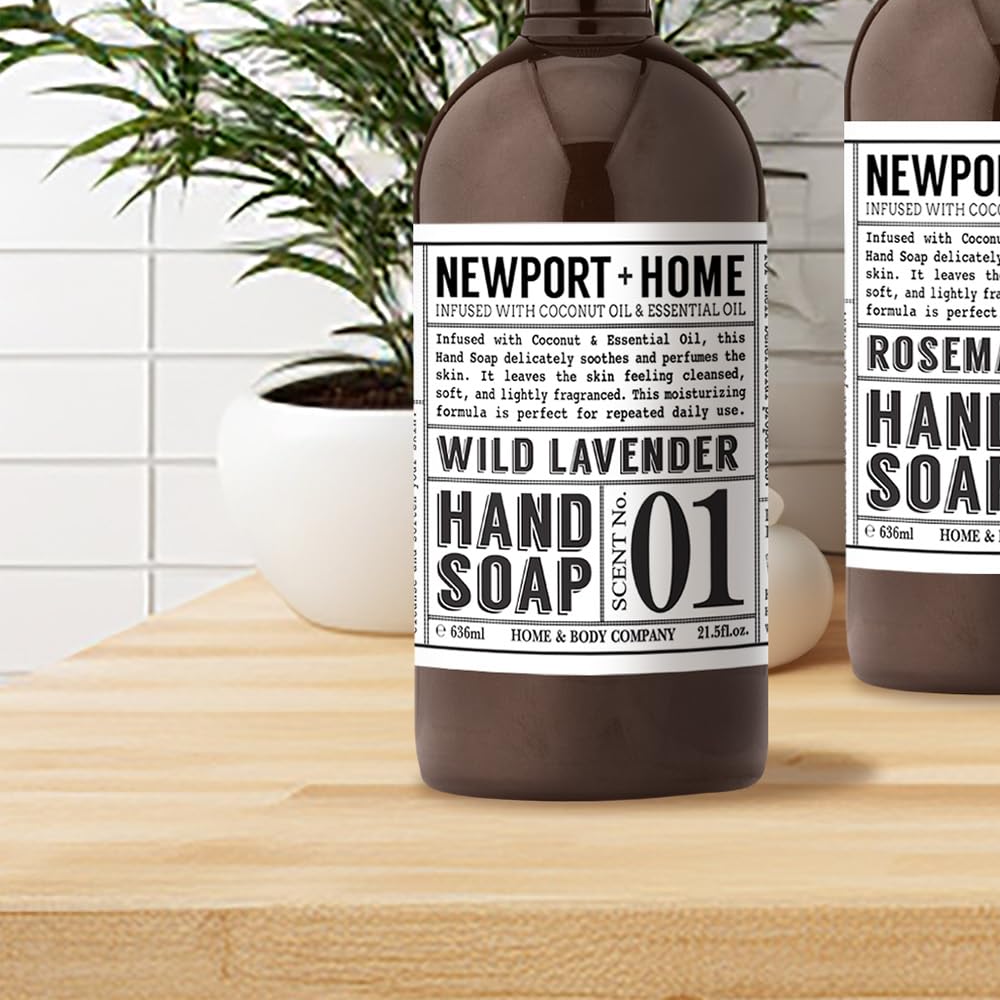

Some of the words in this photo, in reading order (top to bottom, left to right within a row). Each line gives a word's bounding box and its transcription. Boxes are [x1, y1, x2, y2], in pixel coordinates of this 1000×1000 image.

[866, 201, 922, 216] INFUSED
[925, 202, 965, 217] WITH
[866, 230, 915, 244] Infused
[923, 231, 952, 245] with
[865, 249, 894, 262] Hand
[899, 250, 928, 266] Soap
[436, 255, 612, 299] NEWPORT
[617, 266, 633, 286] +
[640, 254, 746, 299] HOME
[865, 267, 899, 280] skin.
[910, 269, 925, 281] It
[934, 268, 976, 281] leaves
[865, 285, 898, 300] soft,
[904, 286, 925, 299] and
[930, 286, 978, 303] lightly
[435, 303, 492, 318] INFUSED
[495, 304, 536, 318] WITH
[538, 303, 606, 319] COCONUT
[608, 303, 633, 318] OIL
[635, 303, 644, 318] &
[647, 302, 721, 318] ESSENTIAL
[722, 301, 747, 317] OIL
[866, 303, 917, 317] formula
[925, 304, 939, 318] is
[946, 305, 998, 321] perfect
[436, 332, 485, 345] Infused
[493, 332, 522, 346] with
[531, 334, 581, 346] Coconut
[590, 335, 598, 346] &
[607, 332, 670, 346] Essential
[678, 331, 707, 347] Oil,
[716, 330, 746, 345] this
[435, 350, 464, 363] Hand
[469, 351, 498, 367] Soap
[503, 351, 575, 368] delicately
[580, 351, 630, 365] soothes
[635, 350, 657, 364] and
[661, 350, 719, 368] perfumes
[724, 348, 746, 362] the
[436, 368, 469, 381] skin.
[481, 370, 495, 382] It
[504, 369, 546, 382] leaves
[555, 369, 577, 383] the
[586, 369, 615, 383] skin
[624, 368, 674, 385] feeling
[682, 366, 745, 382] cleansed,
[435, 386, 468, 401] soft,
[474, 387, 496, 400] and
[500, 387, 548, 404] lightly
[553, 387, 626, 405] fragranced.
[631, 387, 660, 401] This
[663, 385, 747, 401] moisturizing
[436, 404, 487, 418] formula
[495, 405, 509, 419] is
[516, 406, 568, 422] perfect
[577, 406, 598, 420] for
[606, 405, 665, 423] repeated
[671, 404, 709, 421] daily
[716, 406, 745, 417] use.
[436, 435, 534, 475] WILD
[548, 434, 739, 476] LAVENDER
[611, 491, 627, 528] No.
[436, 489, 593, 553] HAND
[879, 525, 915, 541] 636ml
[939, 528, 981, 543] HOME
[984, 528, 995, 543] &
[630, 488, 745, 614] 01
[611, 532, 628, 611] SCENT
[436, 552, 593, 616] SOAP
[449, 624, 486, 641] 636ml
[511, 628, 552, 643] HOME
[555, 629, 566, 643] &
[570, 629, 607, 644] BODY
[610, 627, 677, 644] COMPANY
